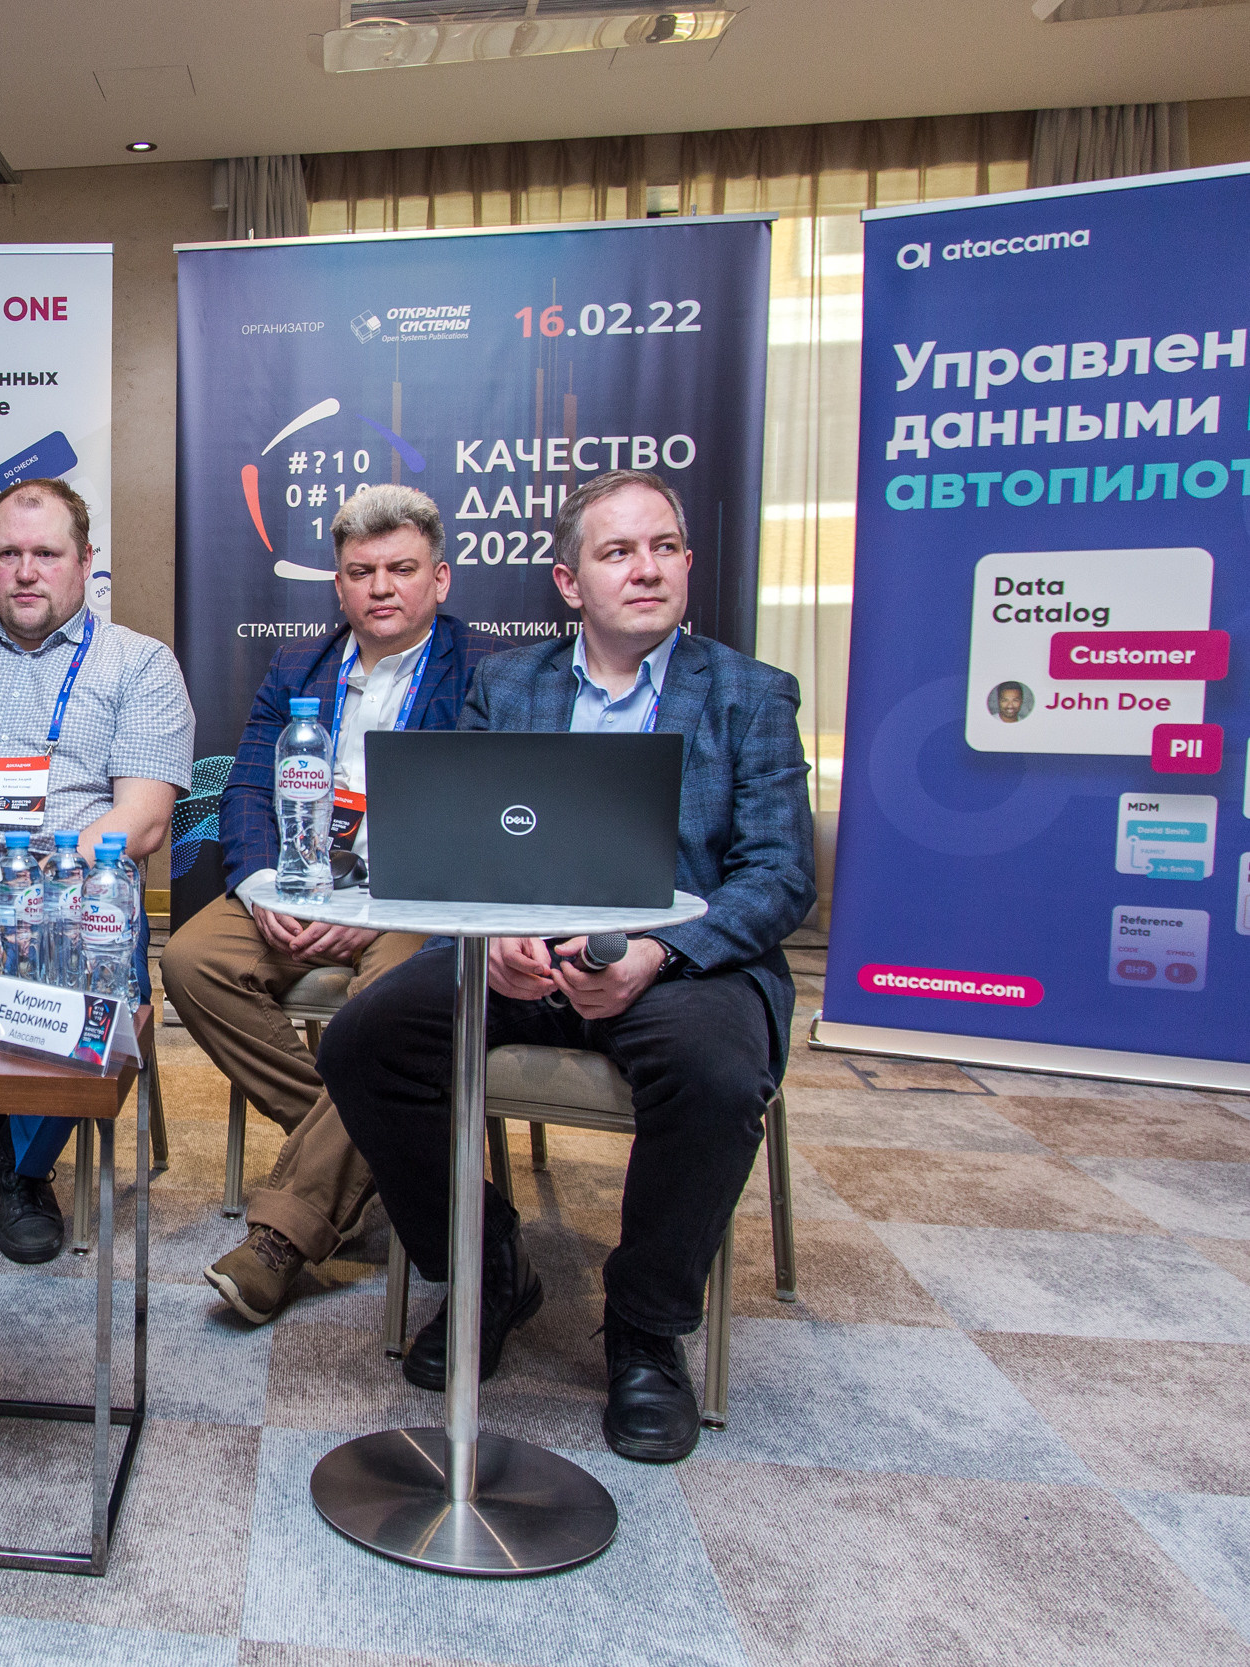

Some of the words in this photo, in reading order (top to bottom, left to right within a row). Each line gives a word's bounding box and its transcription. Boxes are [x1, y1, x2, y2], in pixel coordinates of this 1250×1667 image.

[942, 228, 1091, 262] ataccama
[2, 296, 68, 321] ONE
[386, 305, 471, 320] ОТКРЫТЫЕ
[241, 321, 325, 335] ОРГАНИЗАТОР
[399, 318, 471, 333] СИСТЕМЫ
[514, 300, 701, 338] 16.02.22
[381, 335, 399, 343] Open
[400, 333, 427, 342] Systems
[428, 332, 469, 341] Publications
[893, 328, 1248, 400] Управлен
[885, 395, 1221, 461] данными
[456, 434, 697, 474] КАЧЕСТВО
[3, 469, 14, 479] DQ
[13, 454, 39, 473] CHECKS
[456, 530, 554, 565] 2022
[994, 576, 1065, 597] Data
[992, 601, 1111, 628] Catalog
[236, 623, 326, 638] СТРАТЕГИИ
[1070, 645, 1196, 665] Customer
[1045, 692, 1109, 711] John
[1118, 692, 1171, 711] Doe
[1127, 802, 1160, 812] MDM
[505, 815, 533, 825] DELL
[1137, 826, 1163, 835] David
[1165, 827, 1190, 836] Smith
[1170, 865, 1195, 874] Smith
[1120, 915, 1184, 928] Reference
[1119, 926, 1151, 937] Data
[872, 971, 1025, 998] ataccama.com
[13, 989, 62, 1014] Кирилл
[8, 1028, 46, 1047] Ataccama
